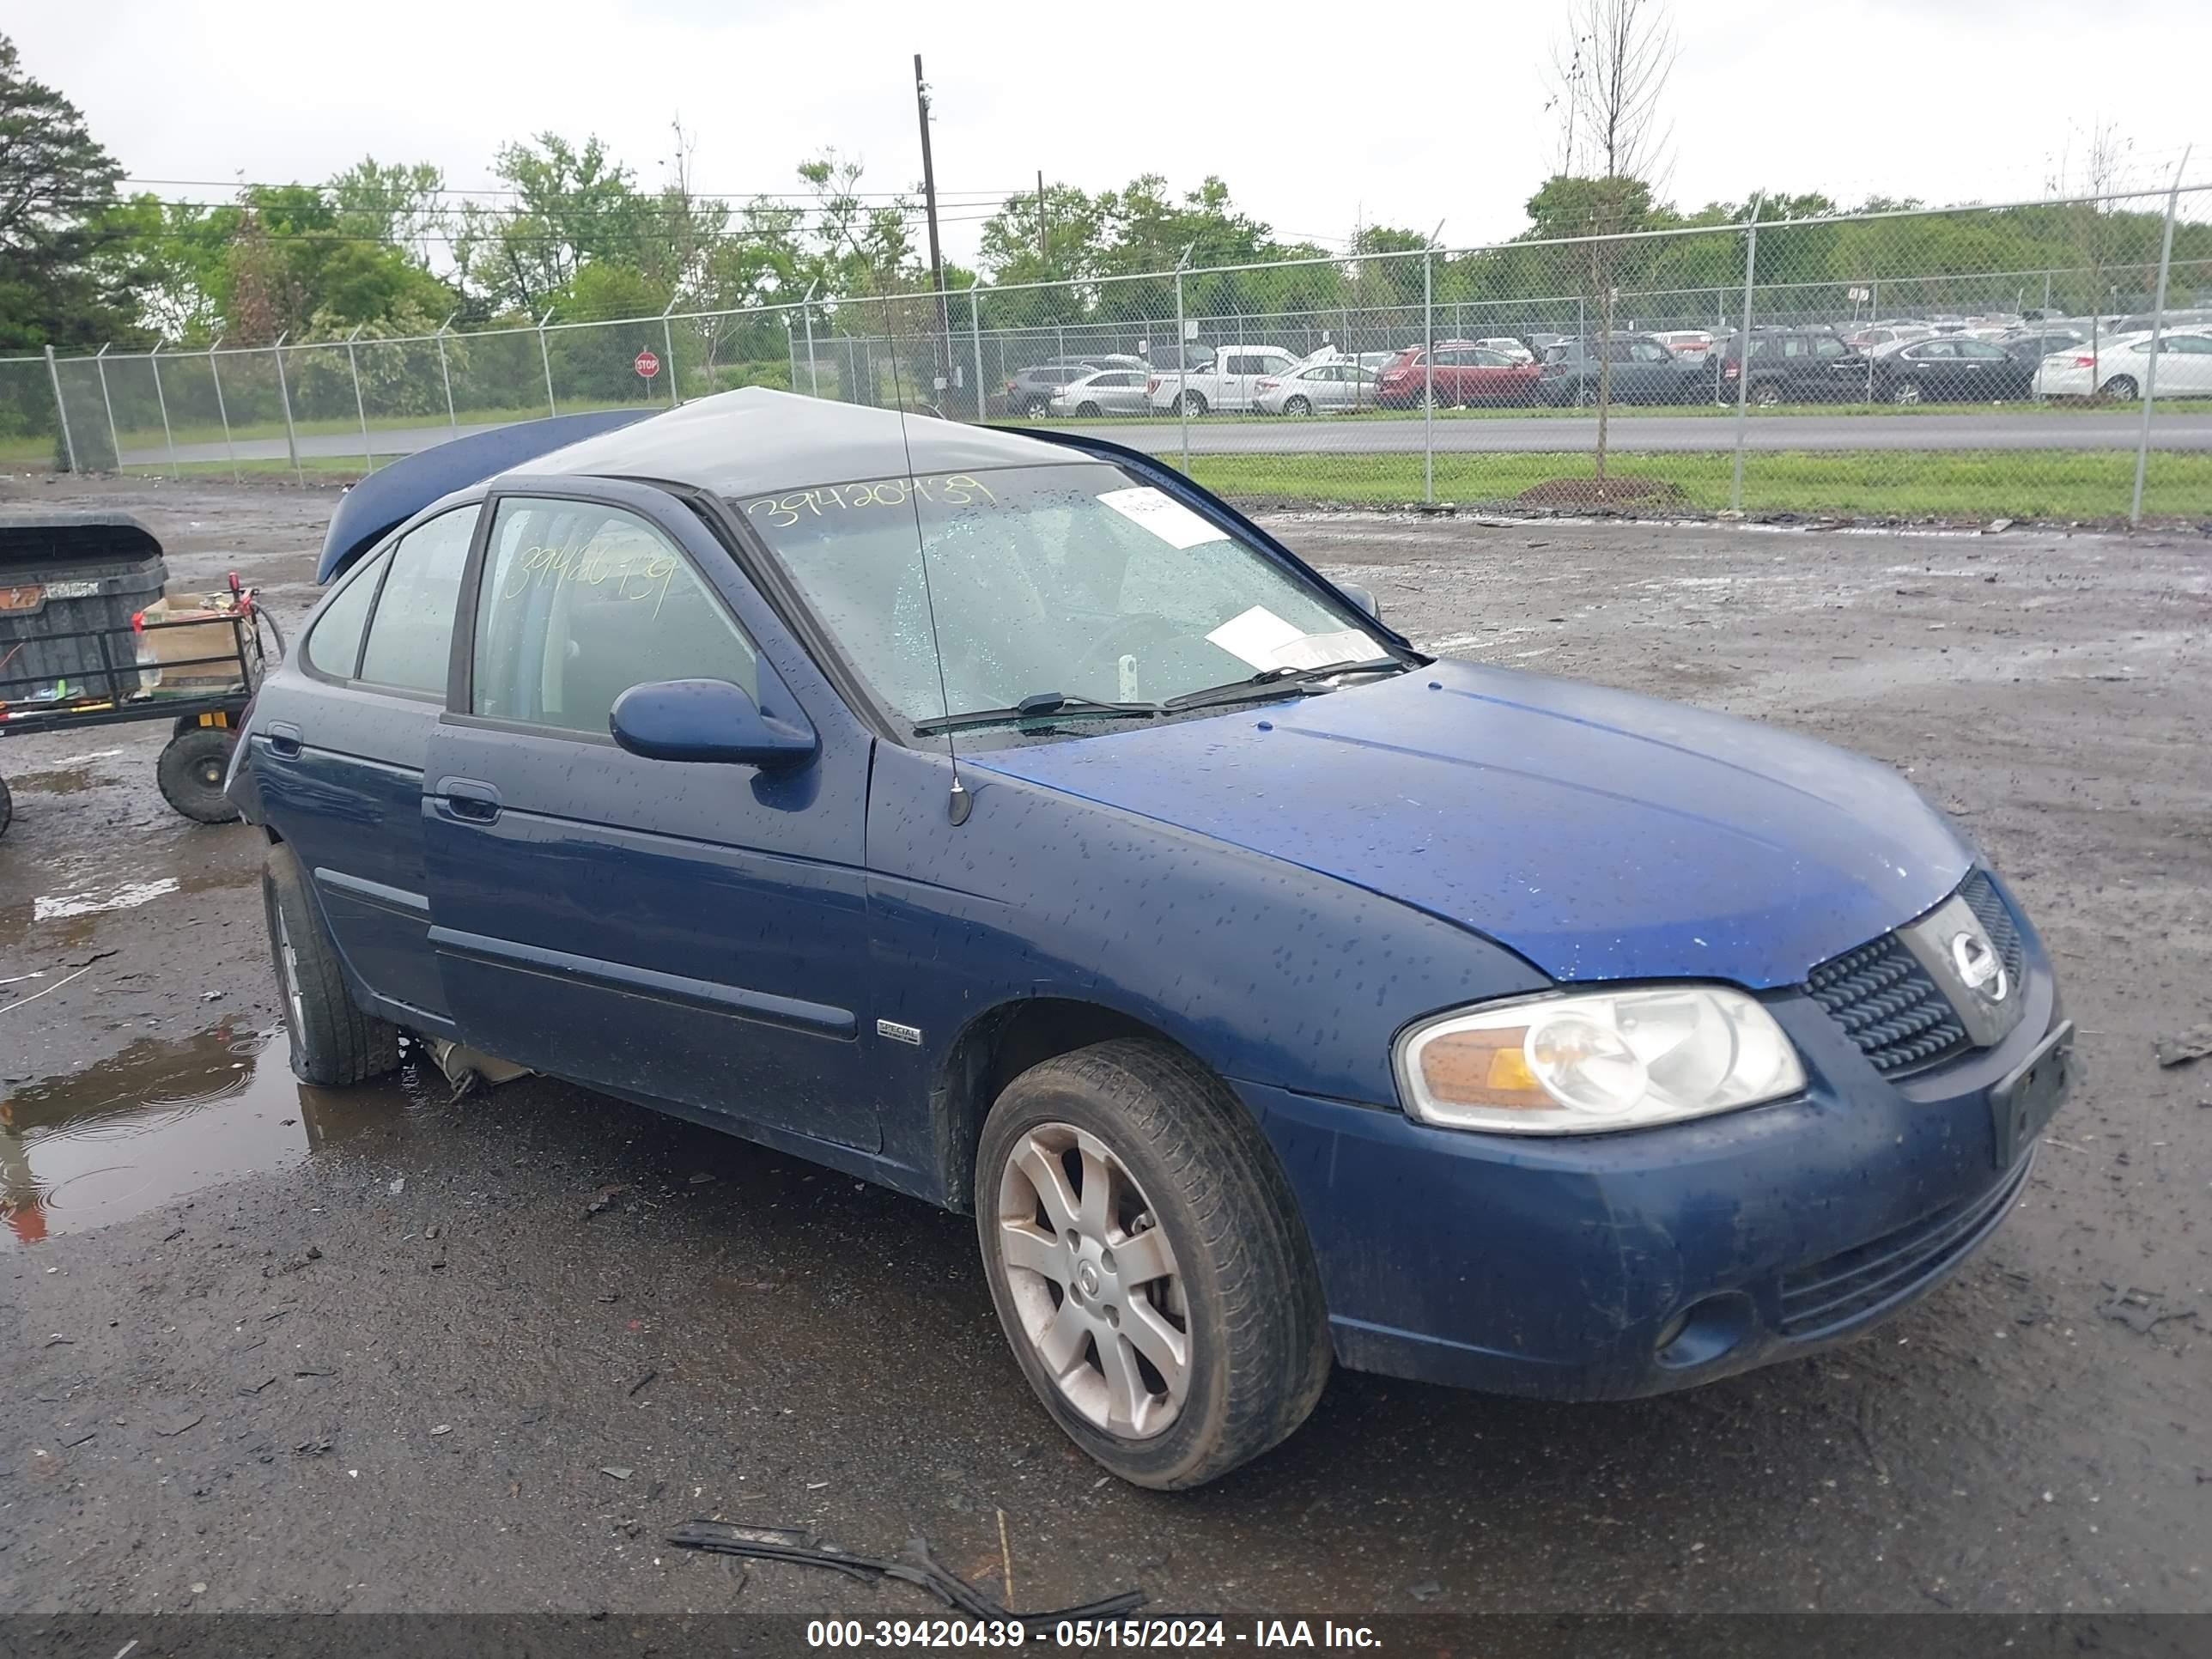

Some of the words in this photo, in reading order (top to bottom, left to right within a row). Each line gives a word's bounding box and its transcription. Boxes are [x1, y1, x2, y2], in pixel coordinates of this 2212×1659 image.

[637, 360, 657, 369] STOP
[748, 475, 999, 527] 39420439
[878, 1022, 919, 1037] SPECIAL
